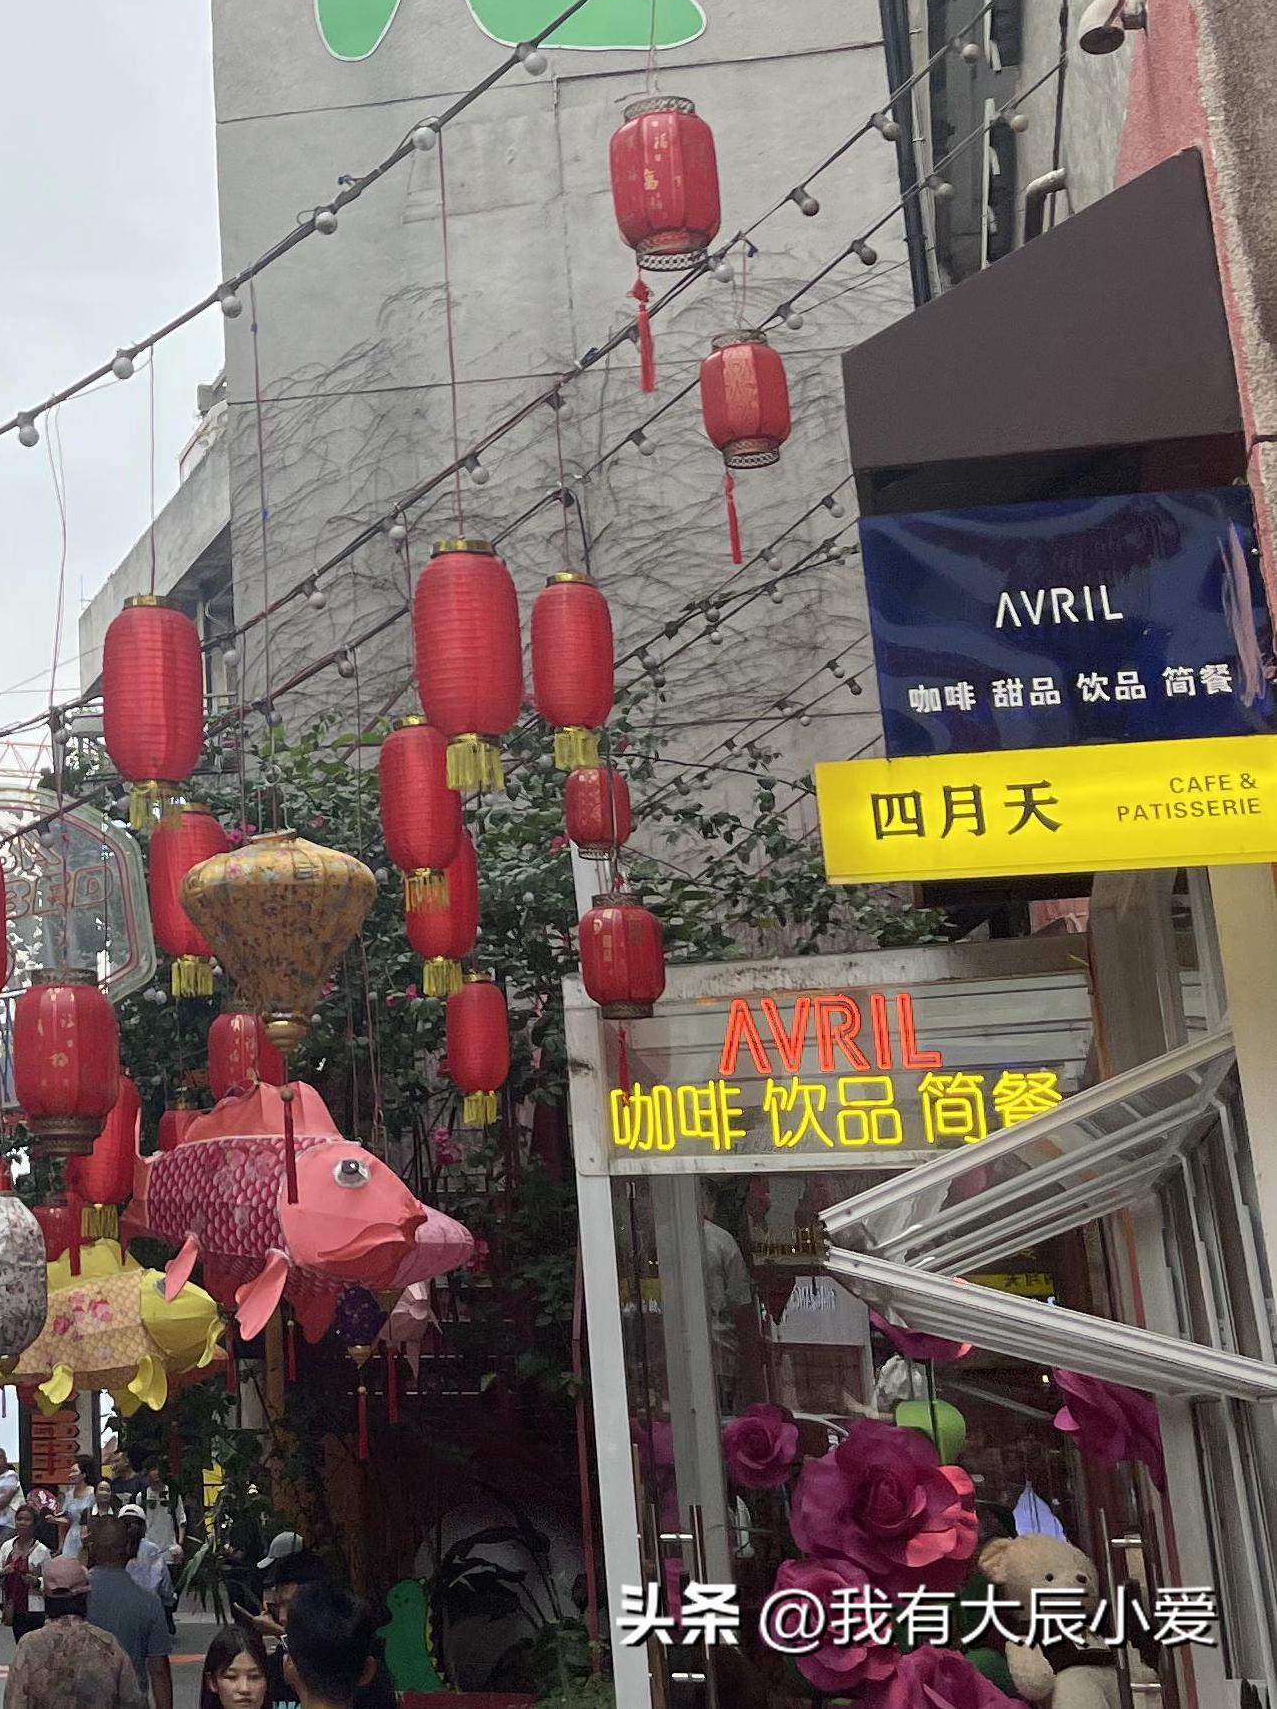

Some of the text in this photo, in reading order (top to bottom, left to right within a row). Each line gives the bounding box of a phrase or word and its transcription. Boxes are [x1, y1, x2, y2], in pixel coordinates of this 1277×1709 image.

[995, 584, 1124, 629] AVRIL
[908, 663, 1234, 714] 咖啡 甜品 饮品 简餐
[1169, 772, 1257, 796] CAFE &
[870, 779, 1063, 841] 四月天
[1116, 798, 1262, 823] PATISSERIE
[719, 993, 942, 1075] AVRIL
[610, 1080, 746, 1151] 咖啡
[762, 1076, 904, 1150] 饮品
